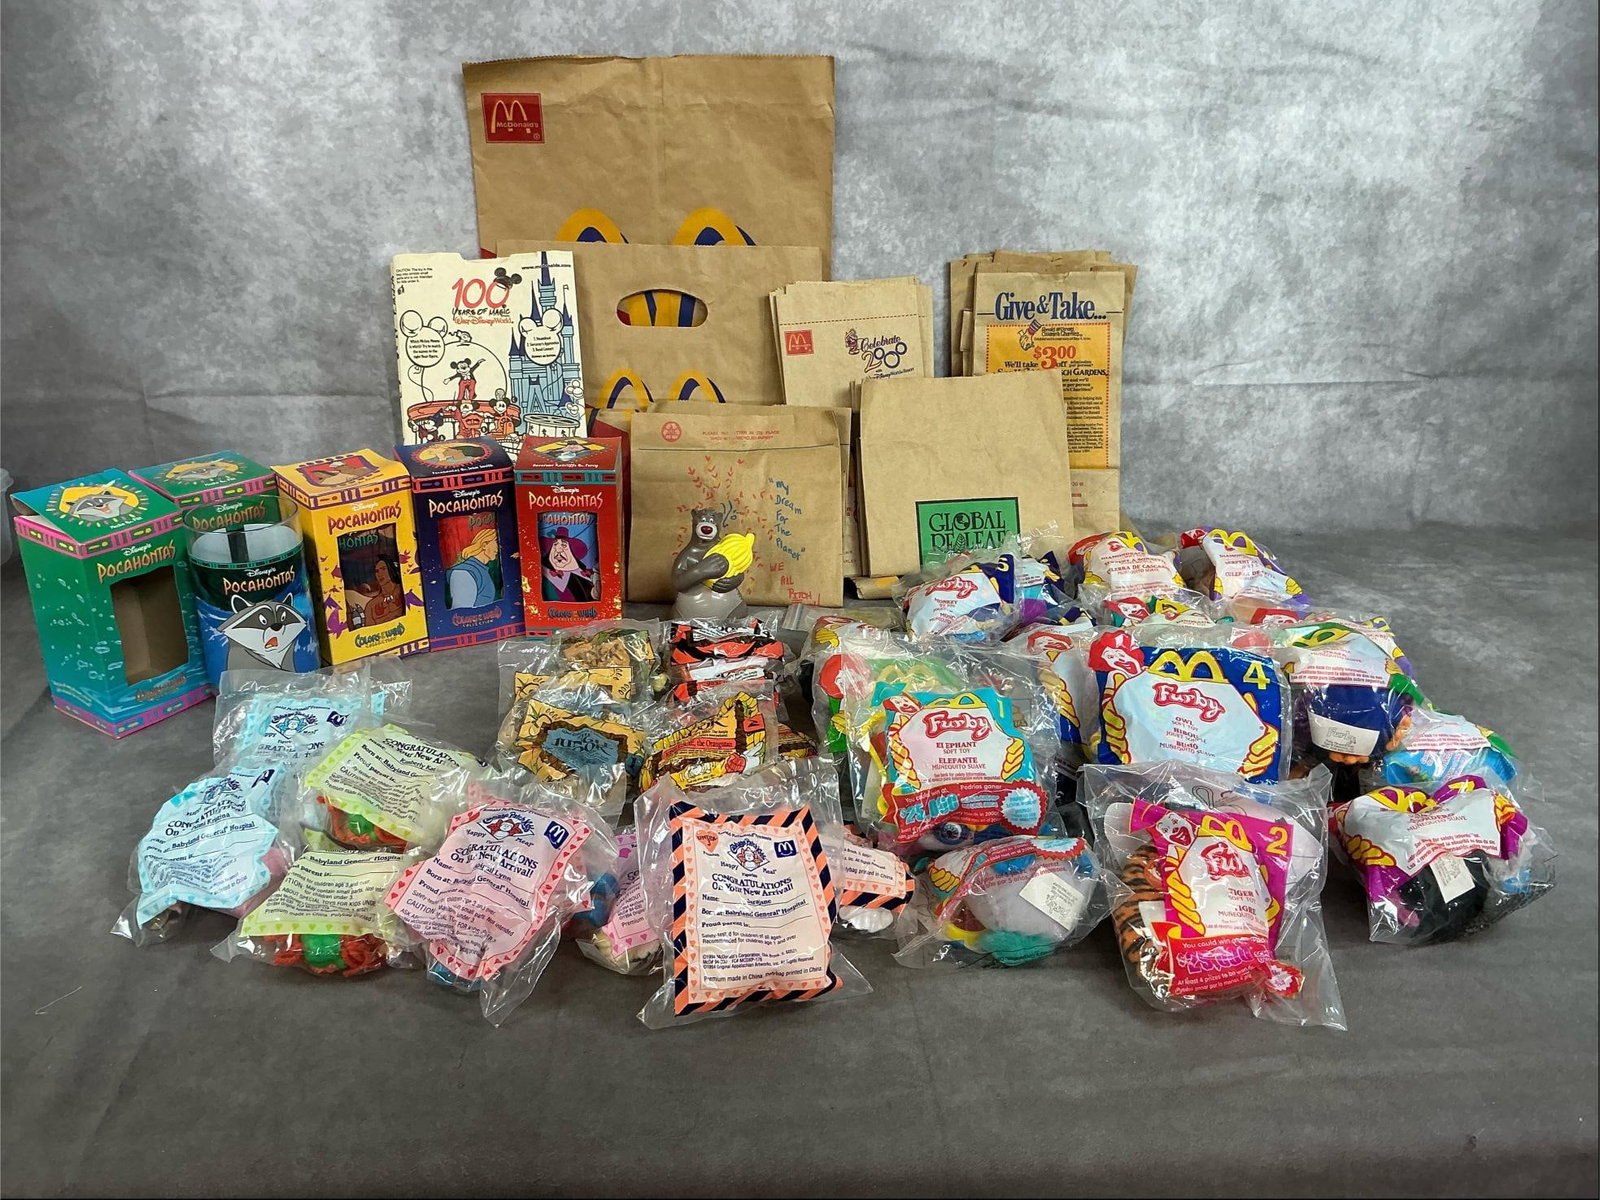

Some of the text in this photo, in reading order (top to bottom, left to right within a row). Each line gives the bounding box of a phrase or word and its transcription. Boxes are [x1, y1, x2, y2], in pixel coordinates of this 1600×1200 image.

[496, 121, 539, 129] McDonald's
[452, 278, 511, 309] 100
[995, 292, 1107, 321] Give & Take...
[452, 308, 511, 321] YEARS OF MAGIC
[861, 335, 901, 351] Celebrate
[862, 342, 908, 374] 2000
[1004, 360, 1022, 368] We'll
[1022, 360, 1039, 368] take
[452, 489, 480, 498] Disney's
[551, 485, 580, 495] Disney's
[352, 502, 379, 512] Disney's
[429, 489, 503, 518] POCAHONTAS
[529, 491, 603, 510] POCAHONTAS
[775, 494, 802, 515] Dream
[215, 502, 243, 513] Disney's
[192, 500, 266, 530] POCAHONTAS
[327, 501, 401, 536] POCAHONTAS
[776, 509, 789, 525] For
[928, 510, 1006, 533] GLOBAL
[774, 523, 792, 537] The
[121, 543, 152, 556] Disney's
[97, 539, 176, 584] POCAHONTAS
[770, 562, 785, 573] WE
[245, 566, 277, 577] Disney's
[223, 565, 296, 595] POCAHONTAS
[1243, 661, 1270, 690] 4
[1152, 682, 1226, 722] Furby
[921, 710, 993, 742] Furby
[1175, 716, 1193, 726] OWL
[1174, 727, 1199, 738] HIBOU
[353, 751, 370, 766] Proud
[362, 743, 411, 776] Born Babyland
[414, 752, 433, 761] New
[165, 827, 179, 836] On
[172, 835, 200, 850] Babyland
[229, 821, 256, 832] Hospital
[1266, 826, 1289, 856] 2
[310, 855, 343, 866] Babyland
[451, 852, 535, 878] On New Arrival!
[301, 866, 323, 877] parent
[426, 868, 441, 880] Born
[494, 869, 512, 881] Lynn
[314, 879, 334, 887] children
[418, 879, 440, 895] Proud
[712, 873, 792, 890] CONGRATULATIONS
[281, 887, 299, 896] ABOUT
[743, 886, 761, 896] New
[762, 883, 794, 897] Arrival!
[461, 906, 475, 915] small
[782, 899, 806, 915] Hospital
[1235, 904, 1257, 916] IGRE
[457, 921, 467, 930] FOR
[702, 920, 721, 928] Proud
[1197, 939, 1217, 947] could
[786, 969, 803, 977] printed
[1204, 975, 1221, 983] prizes
